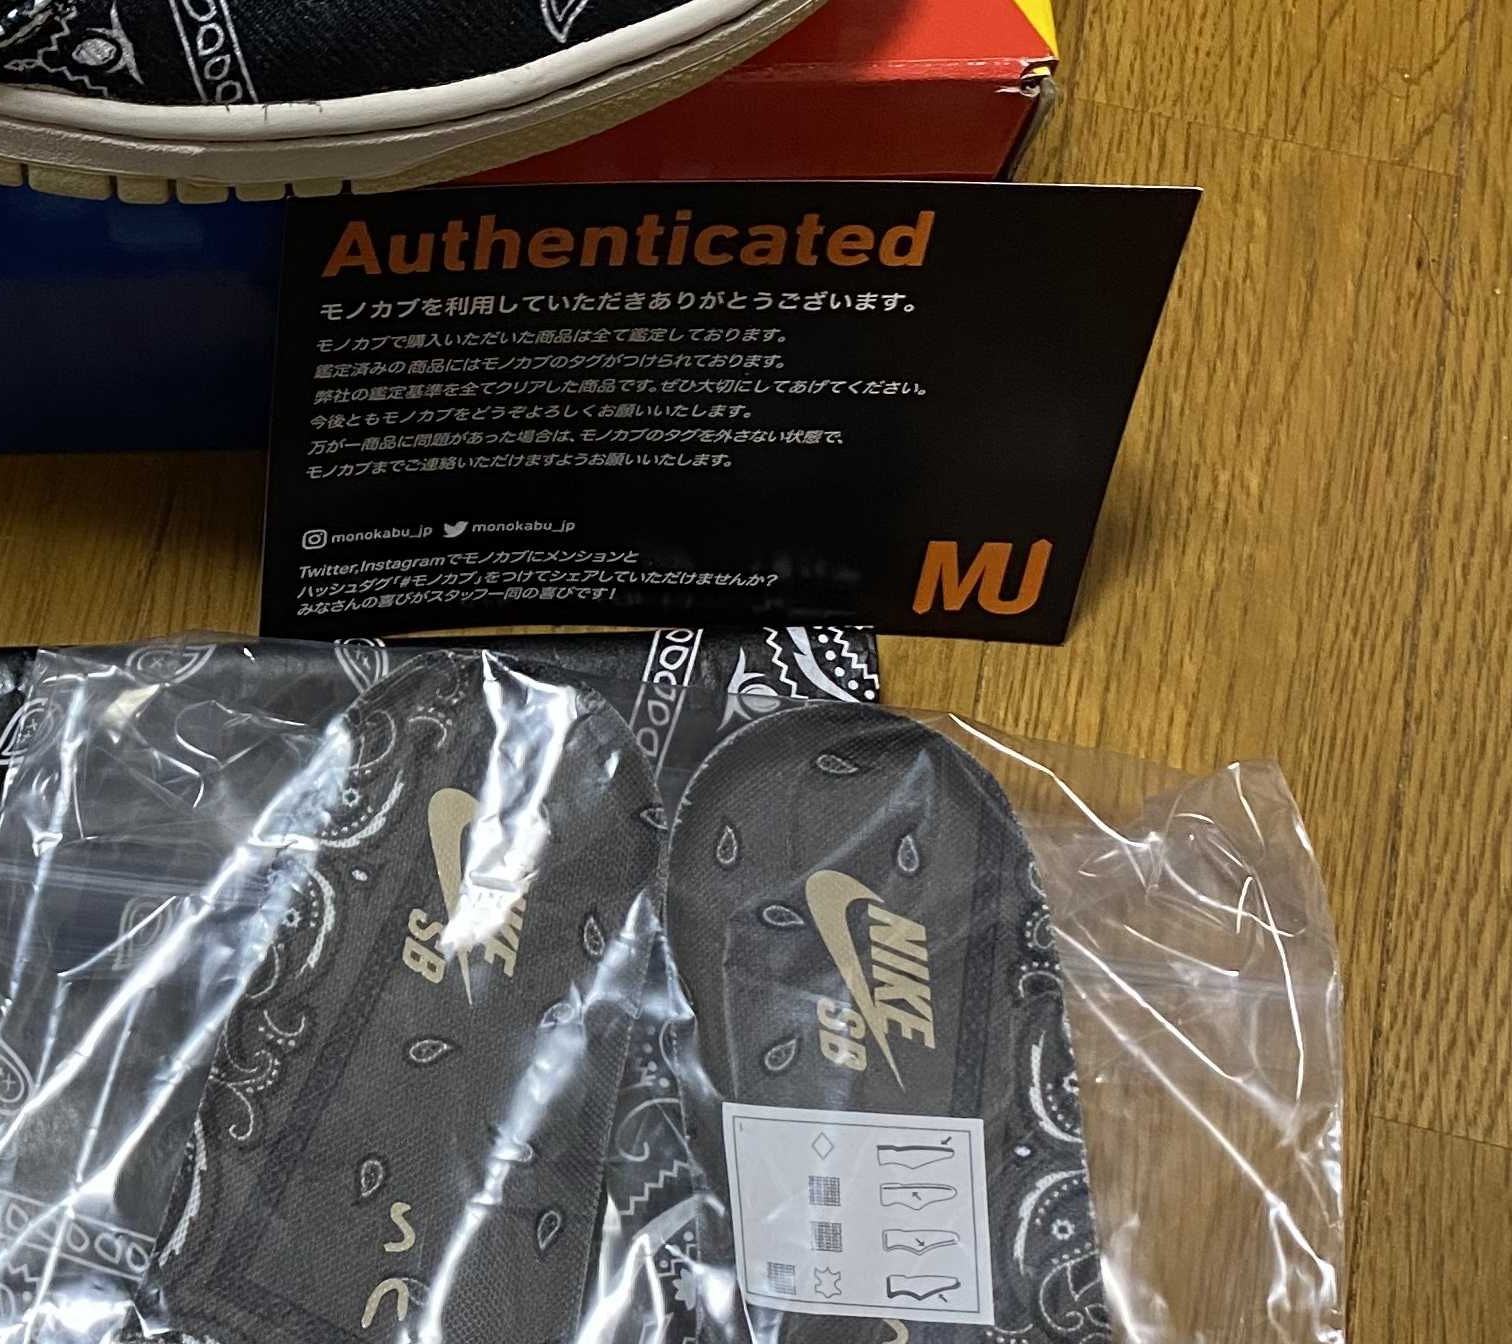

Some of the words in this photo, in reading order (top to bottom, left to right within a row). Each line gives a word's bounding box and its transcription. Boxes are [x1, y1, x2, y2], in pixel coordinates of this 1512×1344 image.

[321, 209, 935, 278] Authenticated
[319, 290, 916, 321] モノカブを利用していただきありがとうございます。
[330, 523, 434, 545] monokabu_jp
[471, 519, 576, 534] monokabu_jp
[402, 908, 446, 984] SB
[867, 903, 936, 1050] NIKE
[816, 997, 868, 1072] SB
